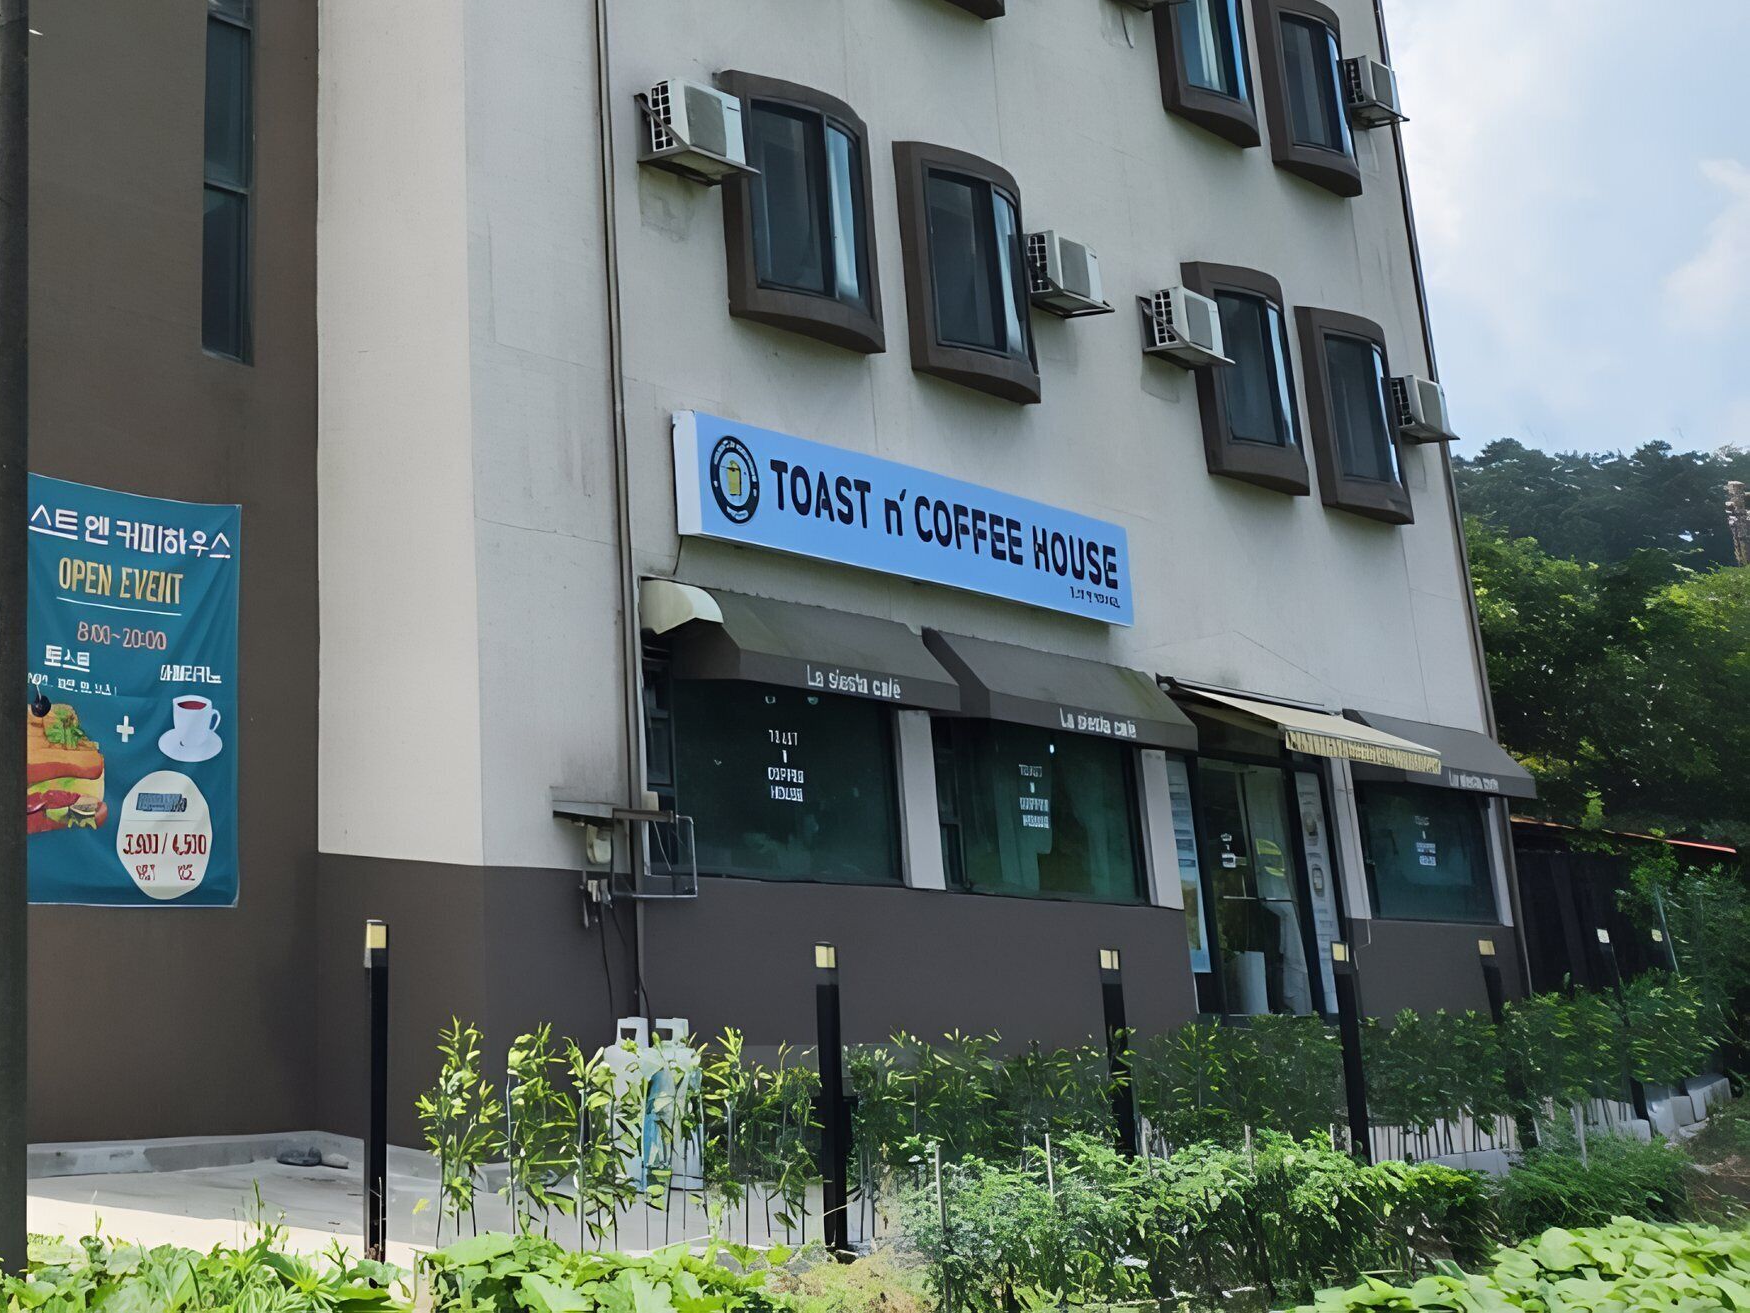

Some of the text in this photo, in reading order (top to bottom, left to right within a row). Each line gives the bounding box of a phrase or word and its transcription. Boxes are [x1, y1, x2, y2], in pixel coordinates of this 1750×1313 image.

[769, 458, 872, 529] TOAST
[914, 495, 1024, 566] COFFEE
[1032, 524, 1119, 590] HOUSE
[58, 557, 184, 605] OPEN EVENT
